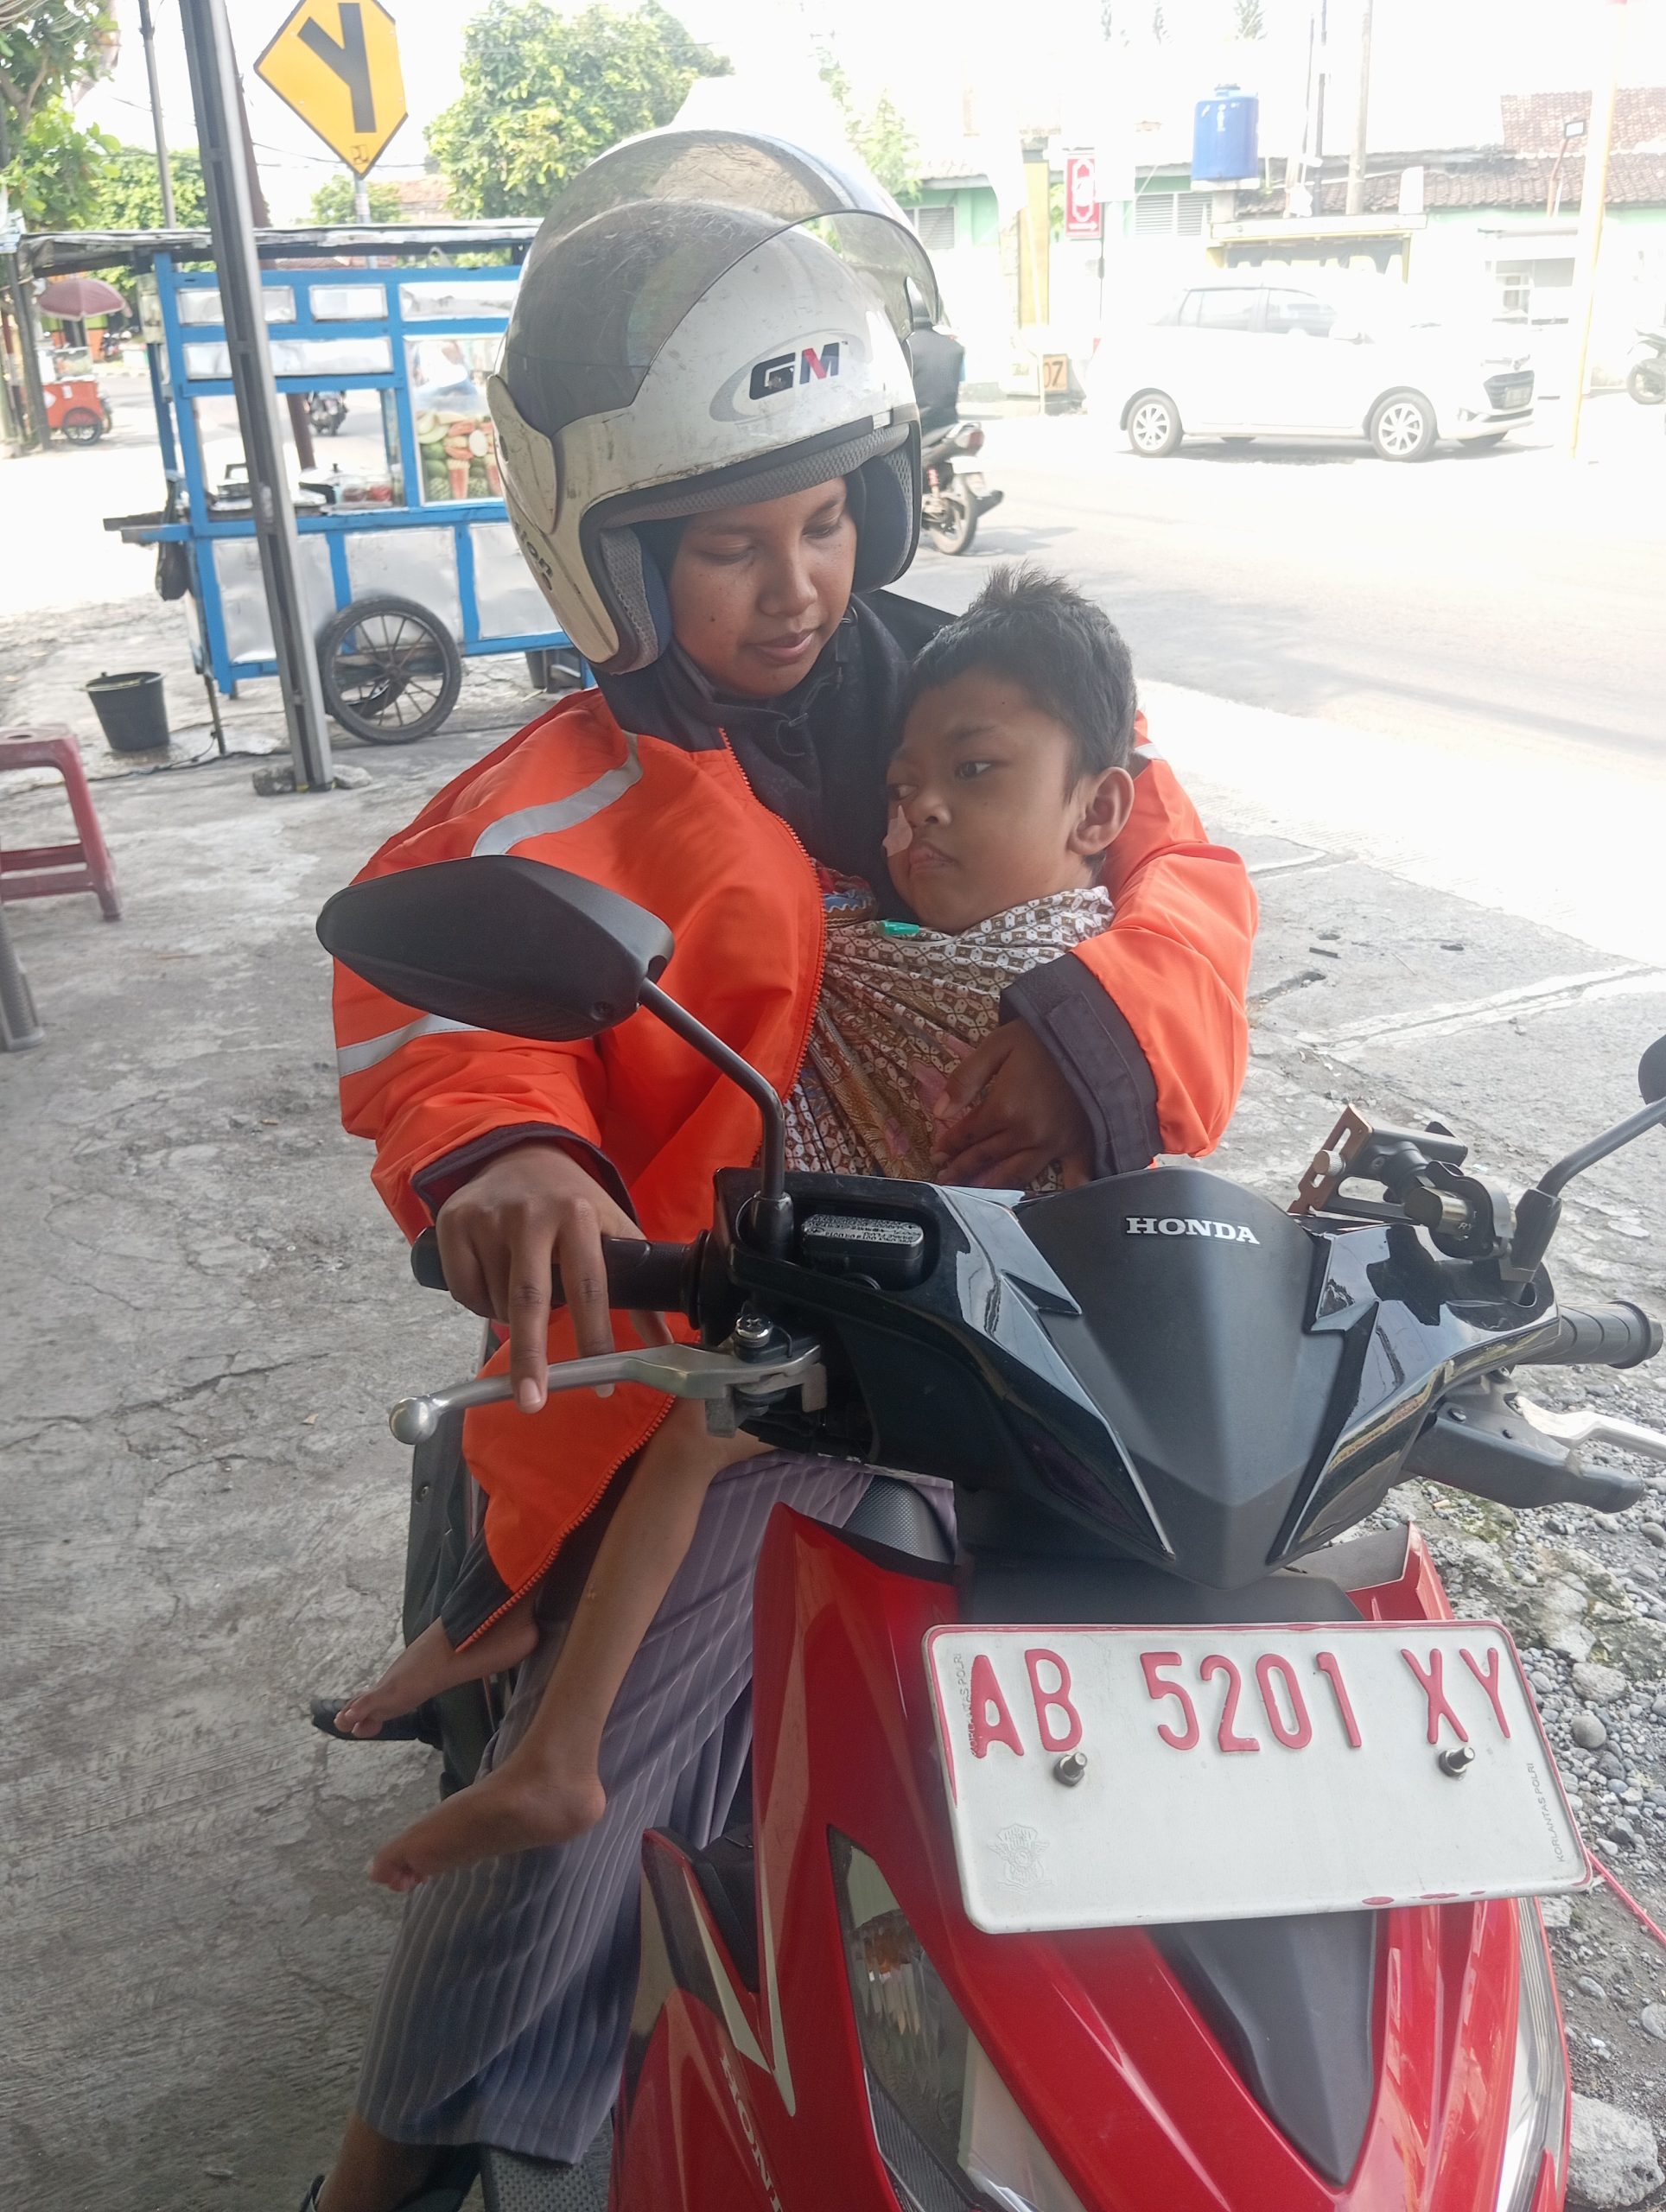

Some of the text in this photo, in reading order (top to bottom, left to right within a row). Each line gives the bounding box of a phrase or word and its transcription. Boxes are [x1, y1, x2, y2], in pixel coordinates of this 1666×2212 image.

[749, 341, 840, 400] GM
[1126, 1217, 1261, 1245] HONDA
[969, 1648, 1511, 1759] AB 5201 XY
[1527, 1763, 1566, 1863] KORLANTAS POLRI
